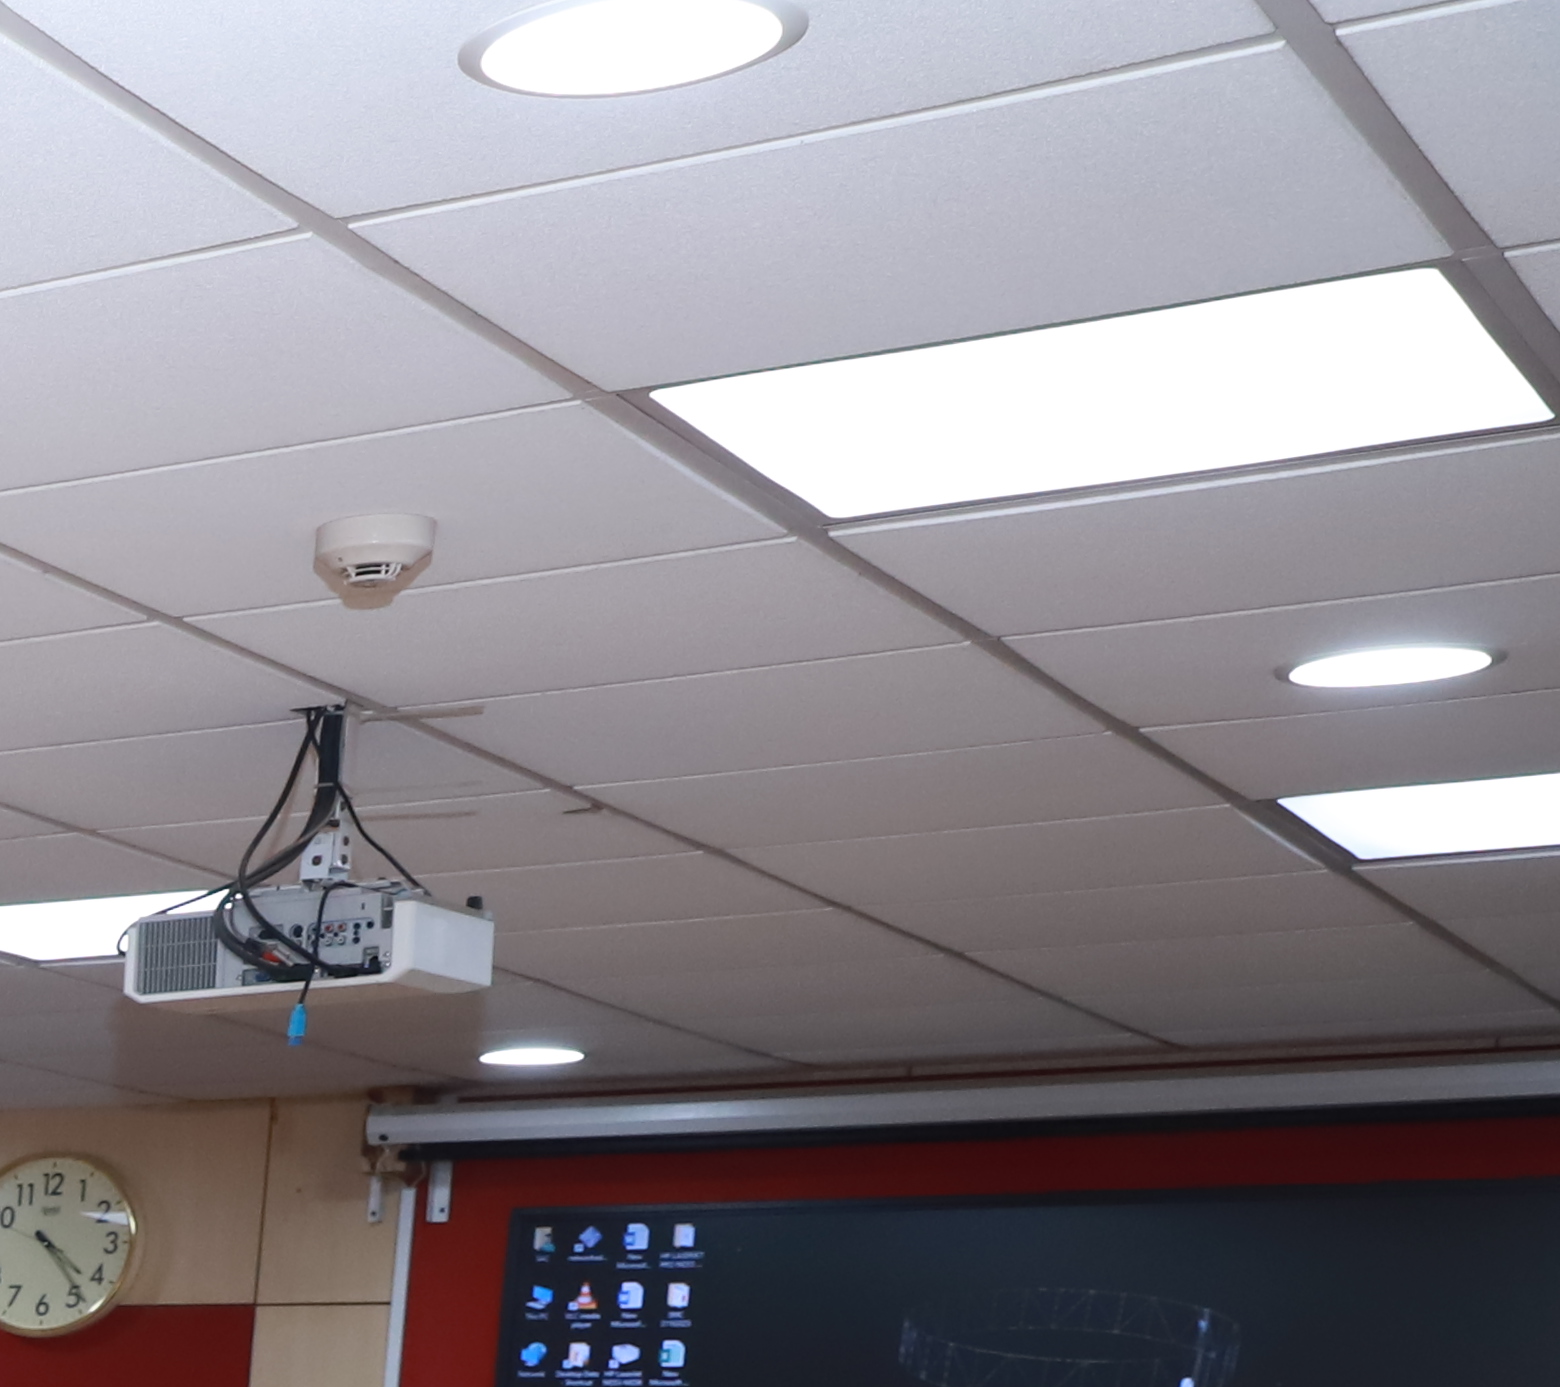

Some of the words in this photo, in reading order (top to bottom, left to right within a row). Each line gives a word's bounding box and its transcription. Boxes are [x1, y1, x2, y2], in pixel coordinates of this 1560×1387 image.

[17, 1183, 34, 1206] 11
[43, 1173, 64, 1196] 12
[79, 1179, 87, 1201] 1
[95, 1200, 111, 1223] 2
[103, 1231, 119, 1254] 3
[90, 1264, 104, 1285] 4
[8, 1285, 23, 1308] 7
[35, 1294, 49, 1316] 6
[65, 1285, 81, 1308] 5
